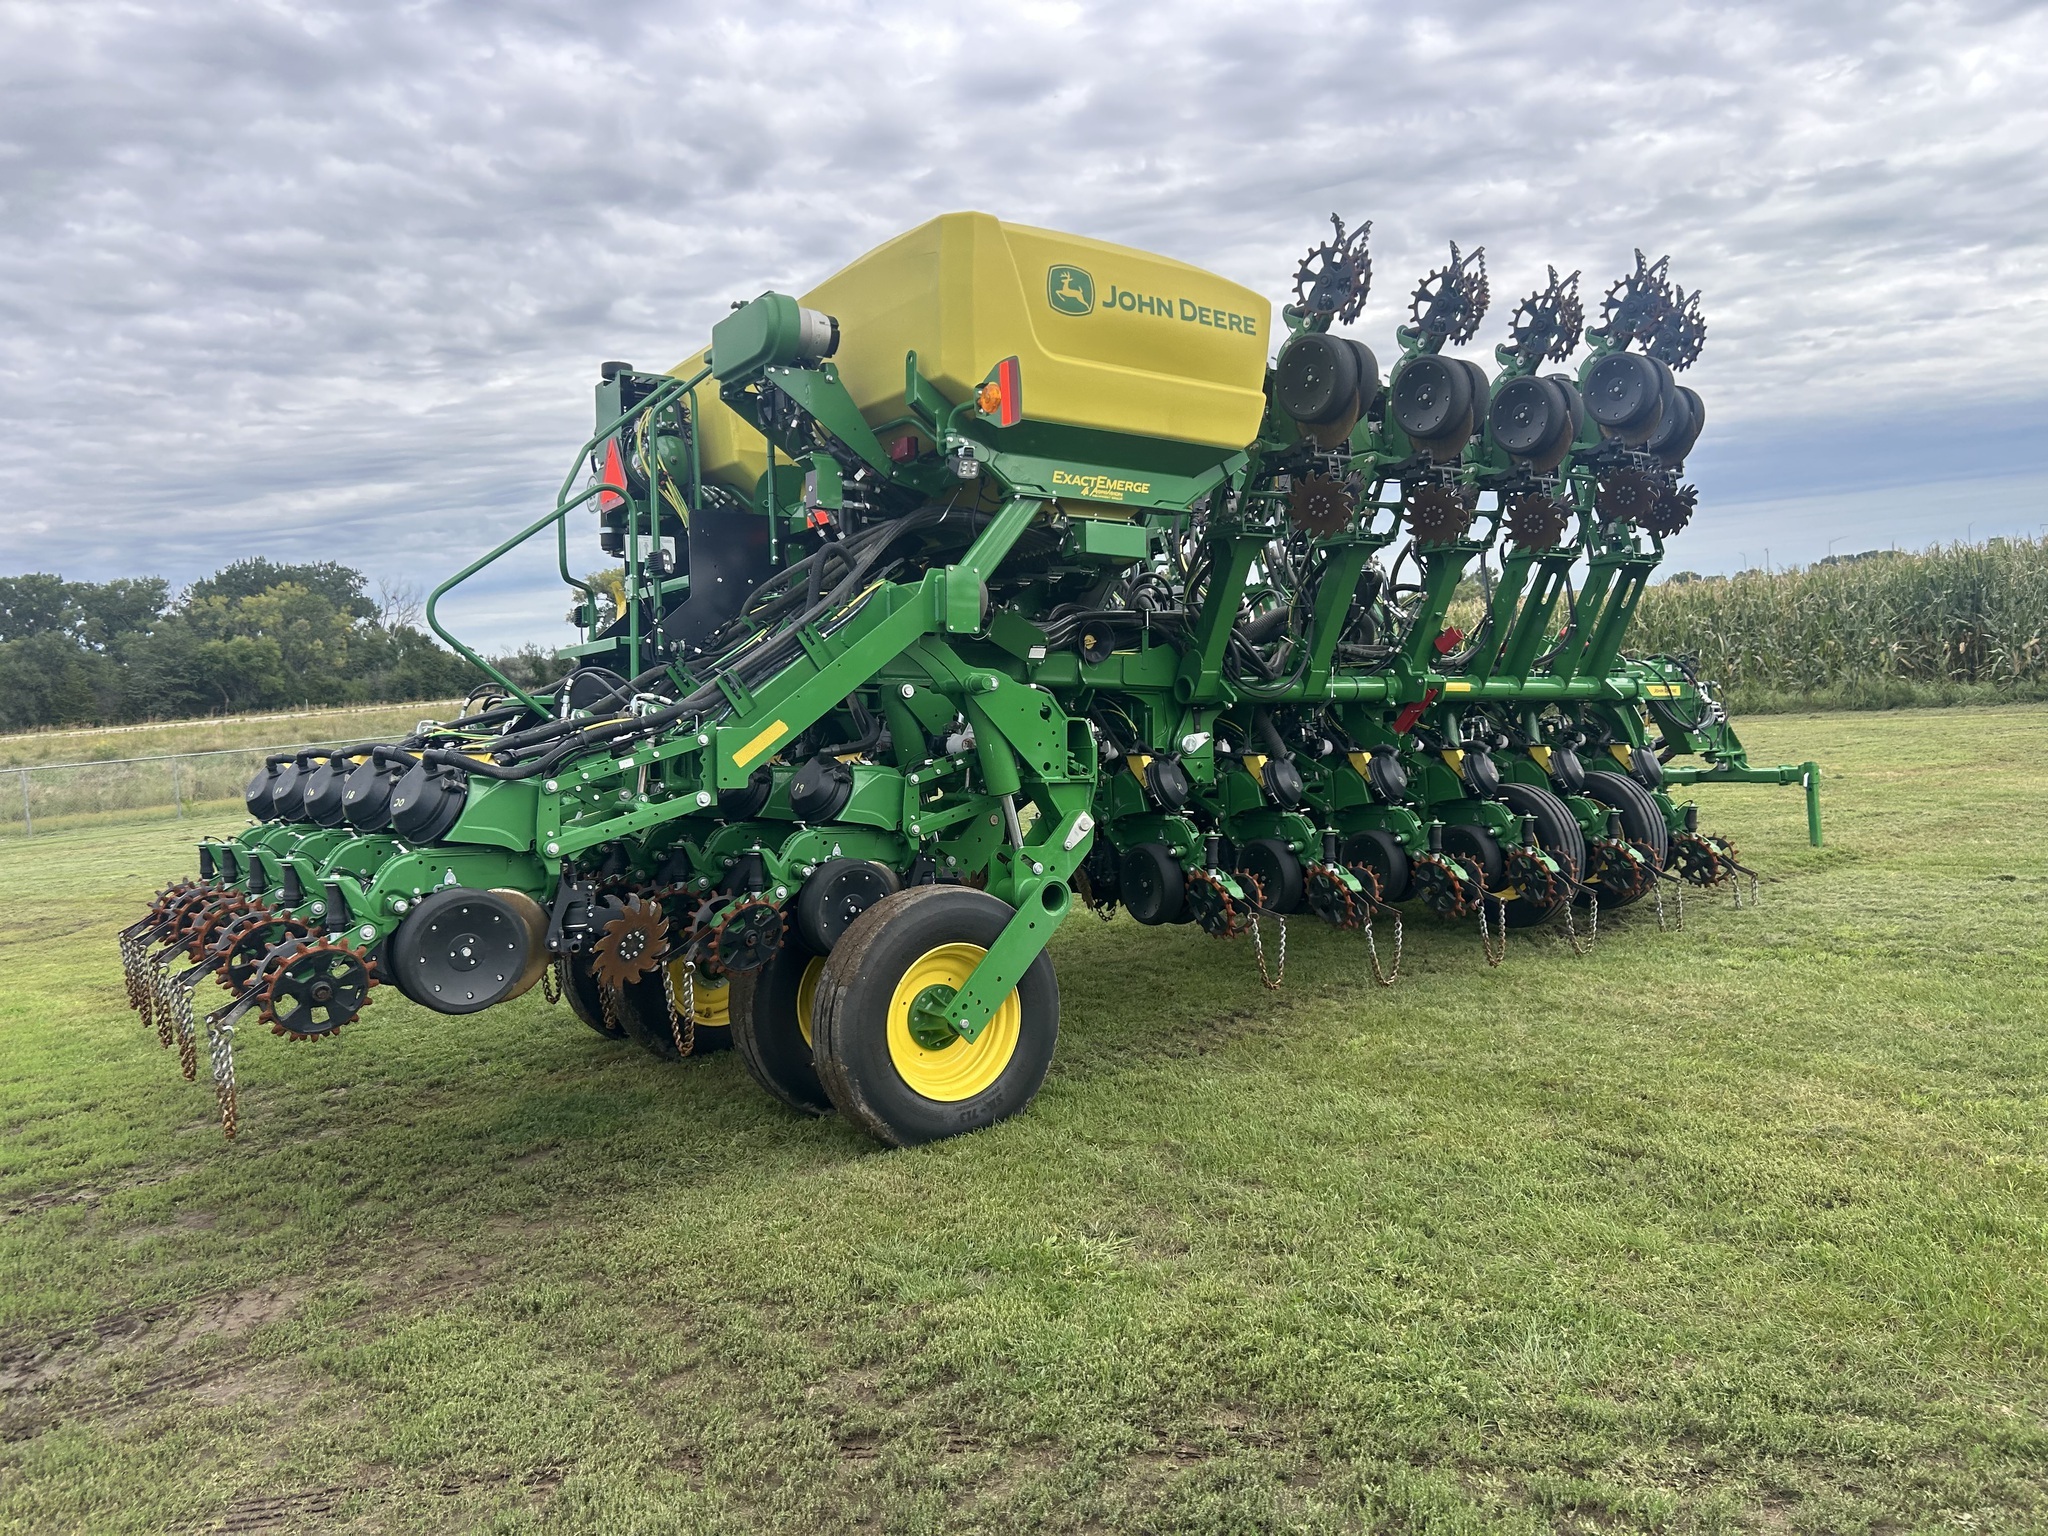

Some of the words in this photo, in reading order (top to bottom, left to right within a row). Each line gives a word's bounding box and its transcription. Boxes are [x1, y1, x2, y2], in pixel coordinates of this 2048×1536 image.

[1102, 285, 1173, 318] JOHN
[1179, 298, 1257, 336] DEERE
[1052, 470, 1151, 494] EXACTEMERGE
[794, 782, 805, 794] 19
[345, 790, 356, 800] 18
[393, 798, 405, 808] 20
